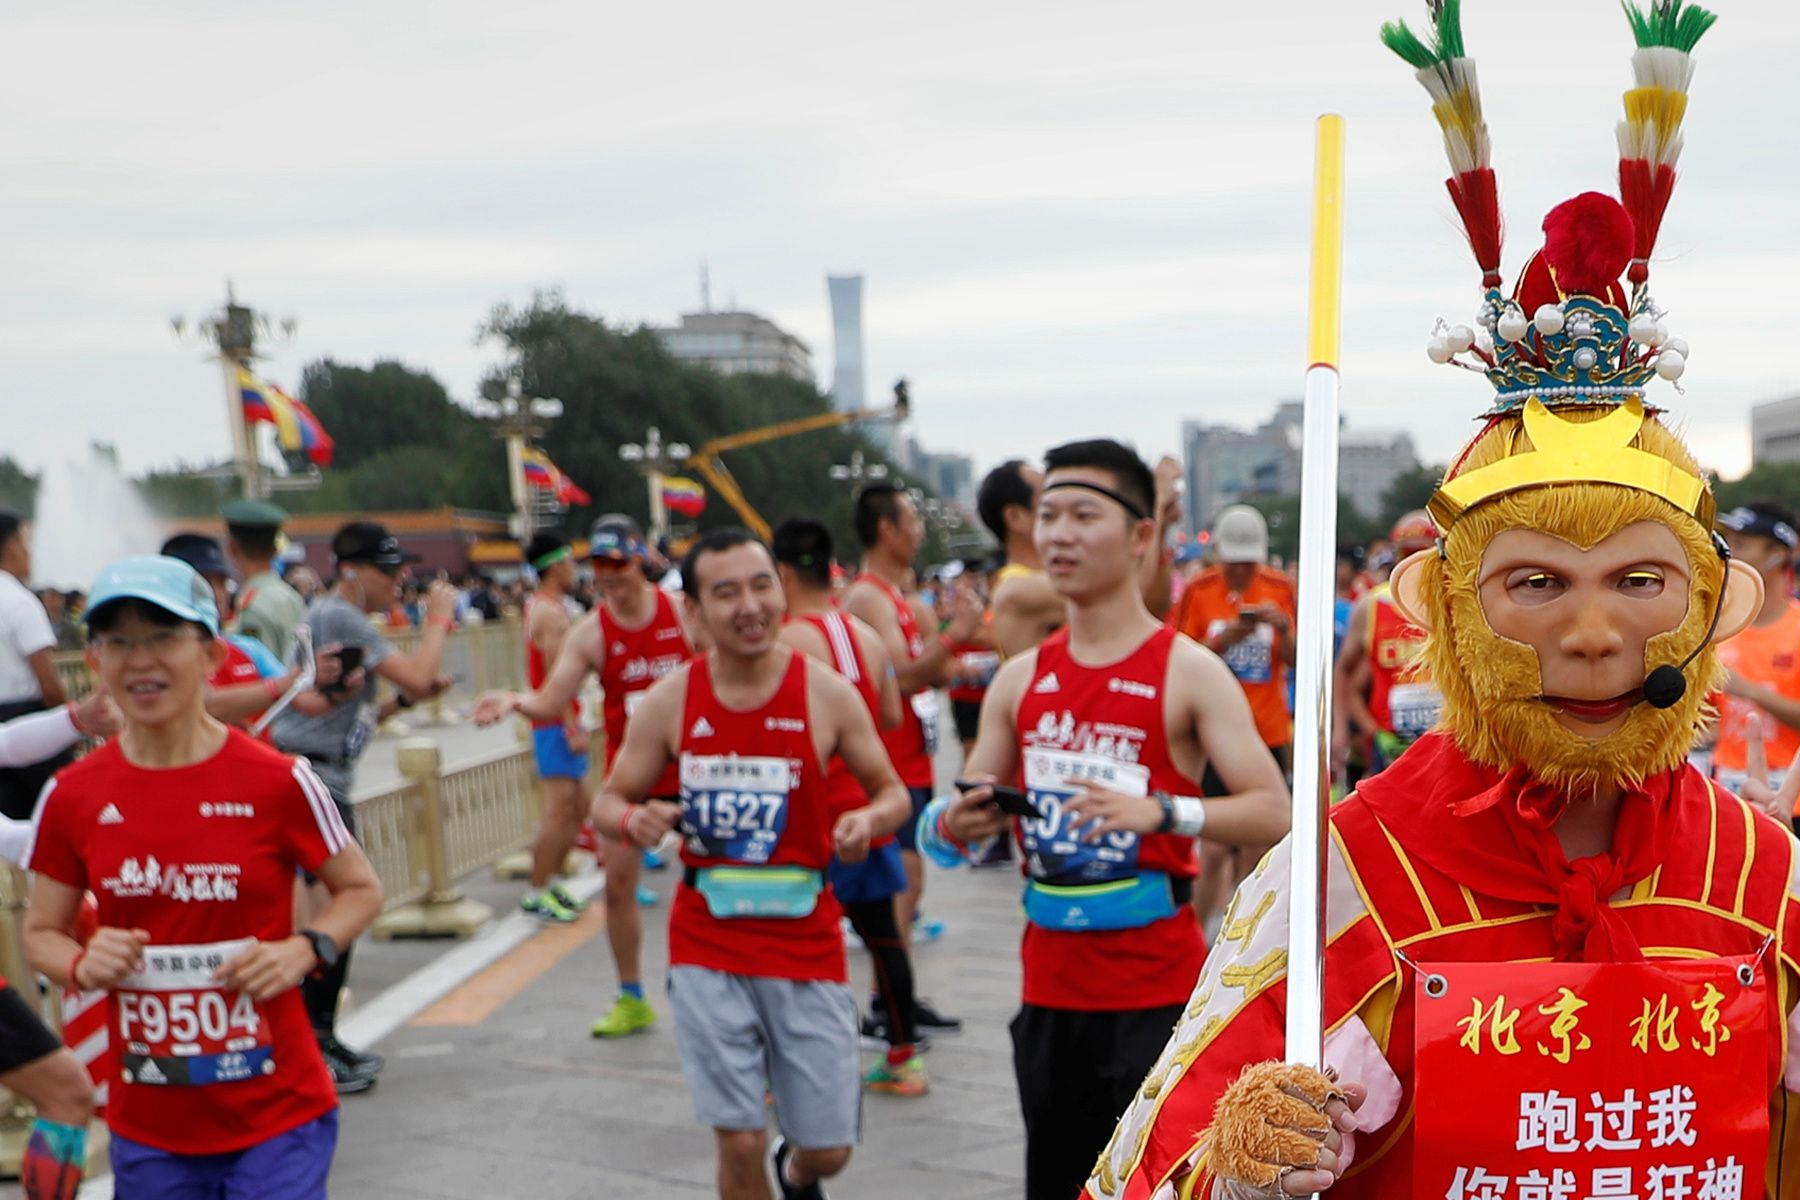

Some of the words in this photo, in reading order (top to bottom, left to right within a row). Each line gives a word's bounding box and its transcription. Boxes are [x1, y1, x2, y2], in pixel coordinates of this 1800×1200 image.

[117, 991, 260, 1044] F9504
[1457, 986, 1592, 1064] 北京
[1628, 982, 1732, 1057] 北京
[1515, 1084, 1698, 1154] 跑过我
